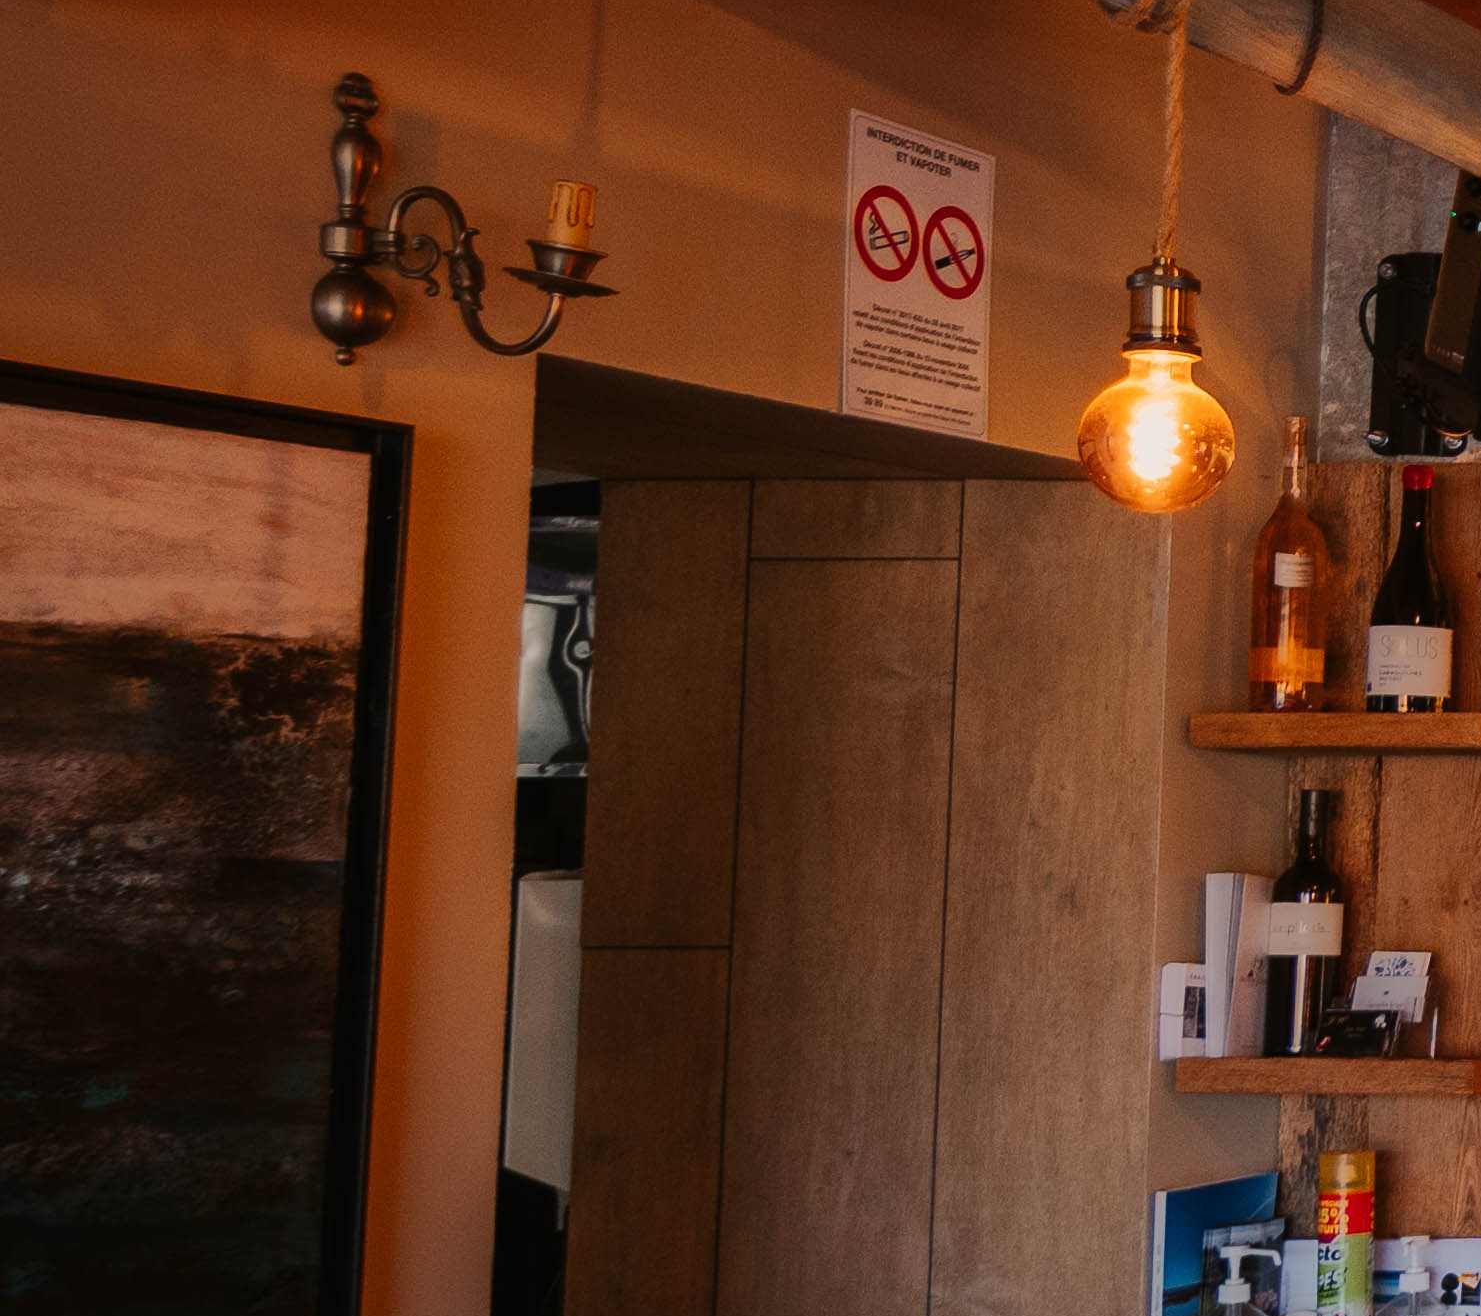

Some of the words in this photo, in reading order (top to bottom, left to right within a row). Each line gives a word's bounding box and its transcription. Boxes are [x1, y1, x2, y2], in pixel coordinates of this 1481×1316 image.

[867, 127, 931, 156] INTERDICTION
[934, 149, 947, 161] DE
[948, 154, 980, 172] FUMER
[896, 151, 908, 163] ET
[910, 155, 952, 177] VAPOTER
[1381, 634, 1439, 659] SLUS
